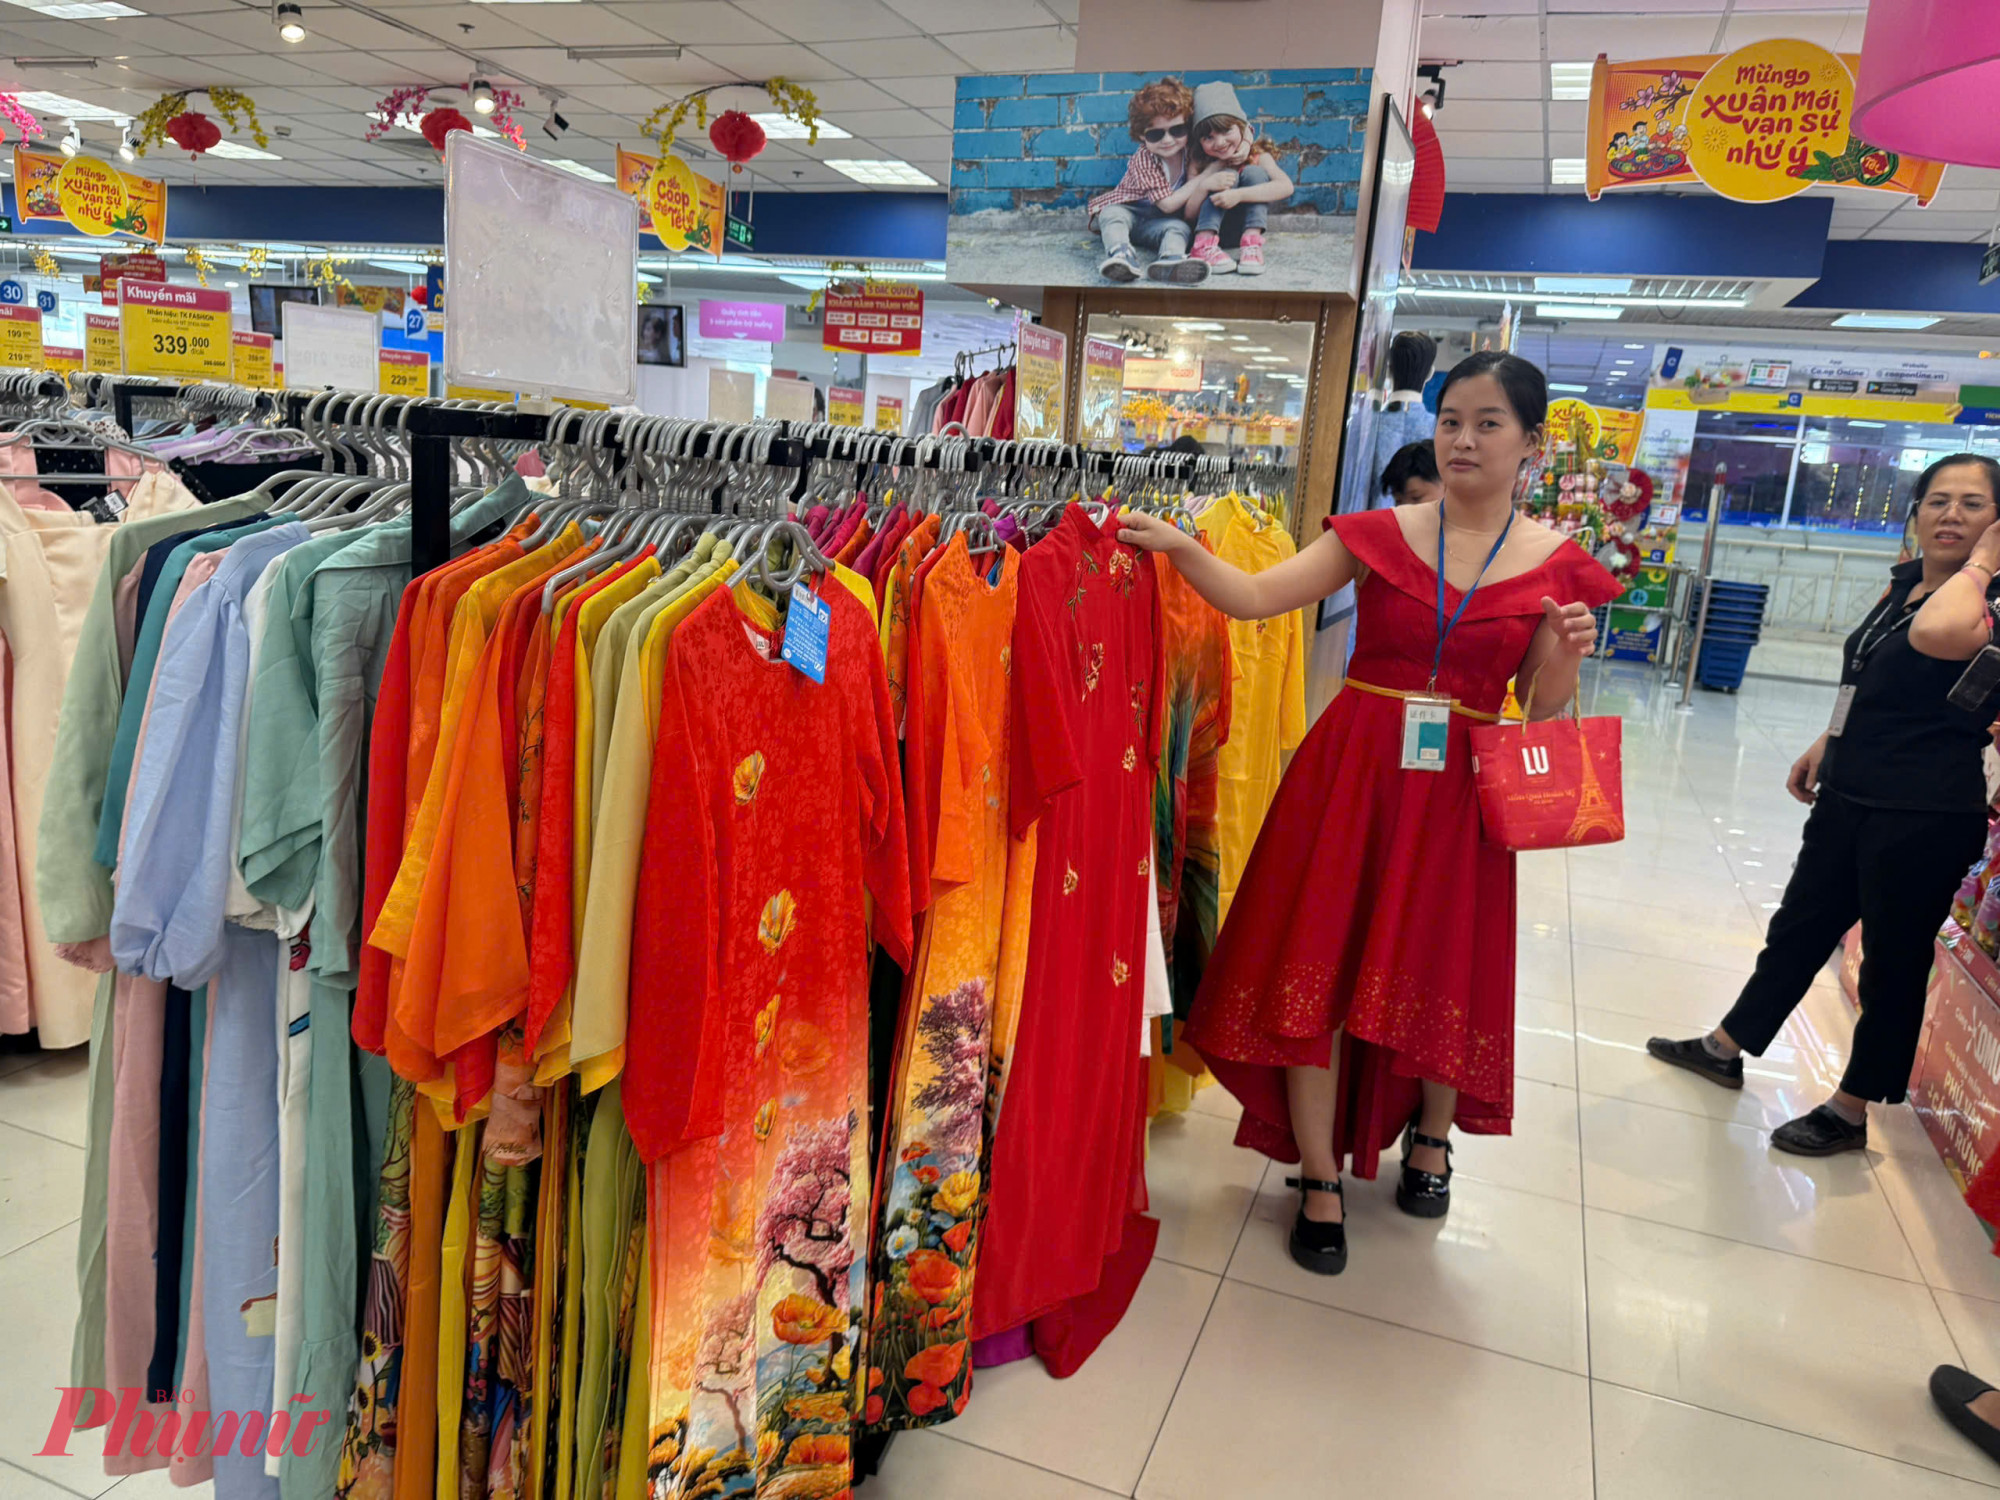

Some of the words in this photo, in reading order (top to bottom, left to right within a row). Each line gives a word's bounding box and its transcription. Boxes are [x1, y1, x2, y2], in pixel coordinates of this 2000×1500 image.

[1735, 64, 1810, 89] Mừng
[1742, 115, 1793, 141] vạn
[1726, 138, 1786, 170] như
[1786, 136, 1812, 177] ý
[3, 285, 21, 300] 30
[126, 285, 173, 303] Khuyến
[175, 292, 197, 304] mãi
[40, 295, 52, 308] 31
[408, 315, 421, 328] 27
[7, 330, 22, 338] 199
[153, 333, 187, 355] 339
[8, 353, 23, 361] 219
[391, 374, 407, 385] 229
[1521, 746, 1549, 775] LU
